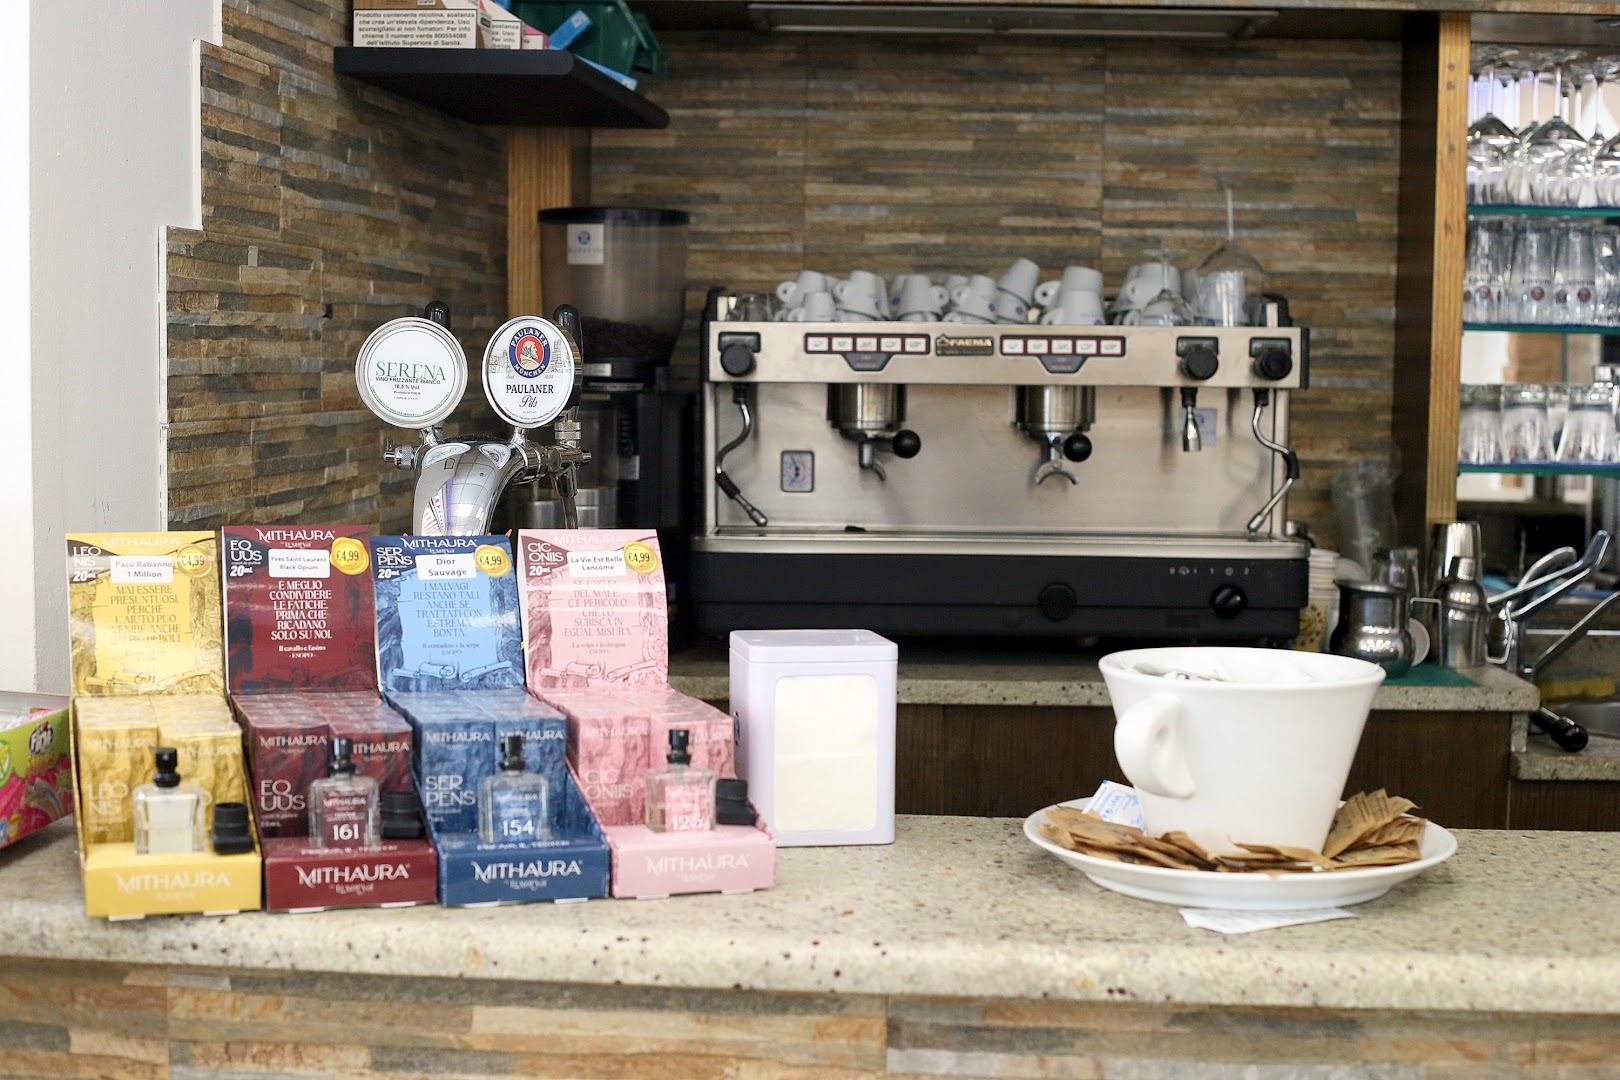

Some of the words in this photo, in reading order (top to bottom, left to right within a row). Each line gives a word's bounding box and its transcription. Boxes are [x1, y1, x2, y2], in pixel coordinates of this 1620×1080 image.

[511, 328, 548, 347] PAULANER
[376, 361, 446, 380] SERENA
[513, 364, 546, 377] MÜNCHEN
[506, 385, 554, 393] PAULANER
[519, 395, 538, 407] Pils
[256, 528, 335, 543] MITHAURA
[552, 534, 624, 544] MITHAURA
[101, 537, 179, 548] MITHAURA
[230, 540, 251, 552] EQ
[400, 538, 477, 549] MITHAURA
[528, 543, 552, 552] CIC
[73, 547, 101, 556] LEO
[231, 551, 262, 561] UUS
[337, 550, 359, 562] €4,99
[376, 547, 402, 556] SER
[74, 557, 96, 566] NIS
[181, 556, 204, 567] €4,99
[378, 556, 413, 566] PENS
[480, 555, 502, 566] €4,99
[628, 552, 650, 563] €4,99
[116, 586, 134, 594] MAI
[137, 585, 173, 594] ESSERE
[287, 580, 323, 590] MEGLIO
[429, 582, 469, 590] MALVAGI
[269, 590, 332, 600] CONDIVIDERE
[413, 591, 456, 600] RESTANO
[574, 590, 591, 598] DEL
[274, 601, 285, 610] LE
[426, 600, 457, 609] ANCHE
[459, 600, 471, 608] SE
[584, 598, 627, 607] PERICOLO
[276, 610, 306, 620] PRIMA
[307, 610, 327, 619] CHE
[416, 610, 462, 618] TRATTATI
[463, 609, 482, 618] CON
[582, 608, 599, 616] CHE
[277, 620, 326, 630] RICADANO
[427, 619, 472, 628] ESTREMA
[574, 618, 612, 627] SUBISCA
[614, 617, 623, 625] IN
[150, 624, 181, 633] ANCHE
[564, 628, 594, 636] EGUAL
[597, 627, 631, 636] MISURA
[271, 630, 297, 640] SOLO
[299, 630, 312, 639] SU
[260, 735, 327, 748] MITHAURA
[425, 731, 490, 744] MITHAURA
[353, 742, 410, 754] ITHAURA
[261, 779, 291, 796] EQ
[425, 775, 463, 790] SER
[88, 783, 129, 800] LEO
[261, 795, 306, 811] UUS
[425, 790, 476, 807] PENS
[333, 824, 358, 841] 161
[502, 820, 534, 836] 154
[646, 854, 749, 876] MITHAURA
[294, 864, 410, 888] MITHAURA
[470, 860, 582, 884] MITHAURA
[115, 872, 230, 895] MITHAURA
